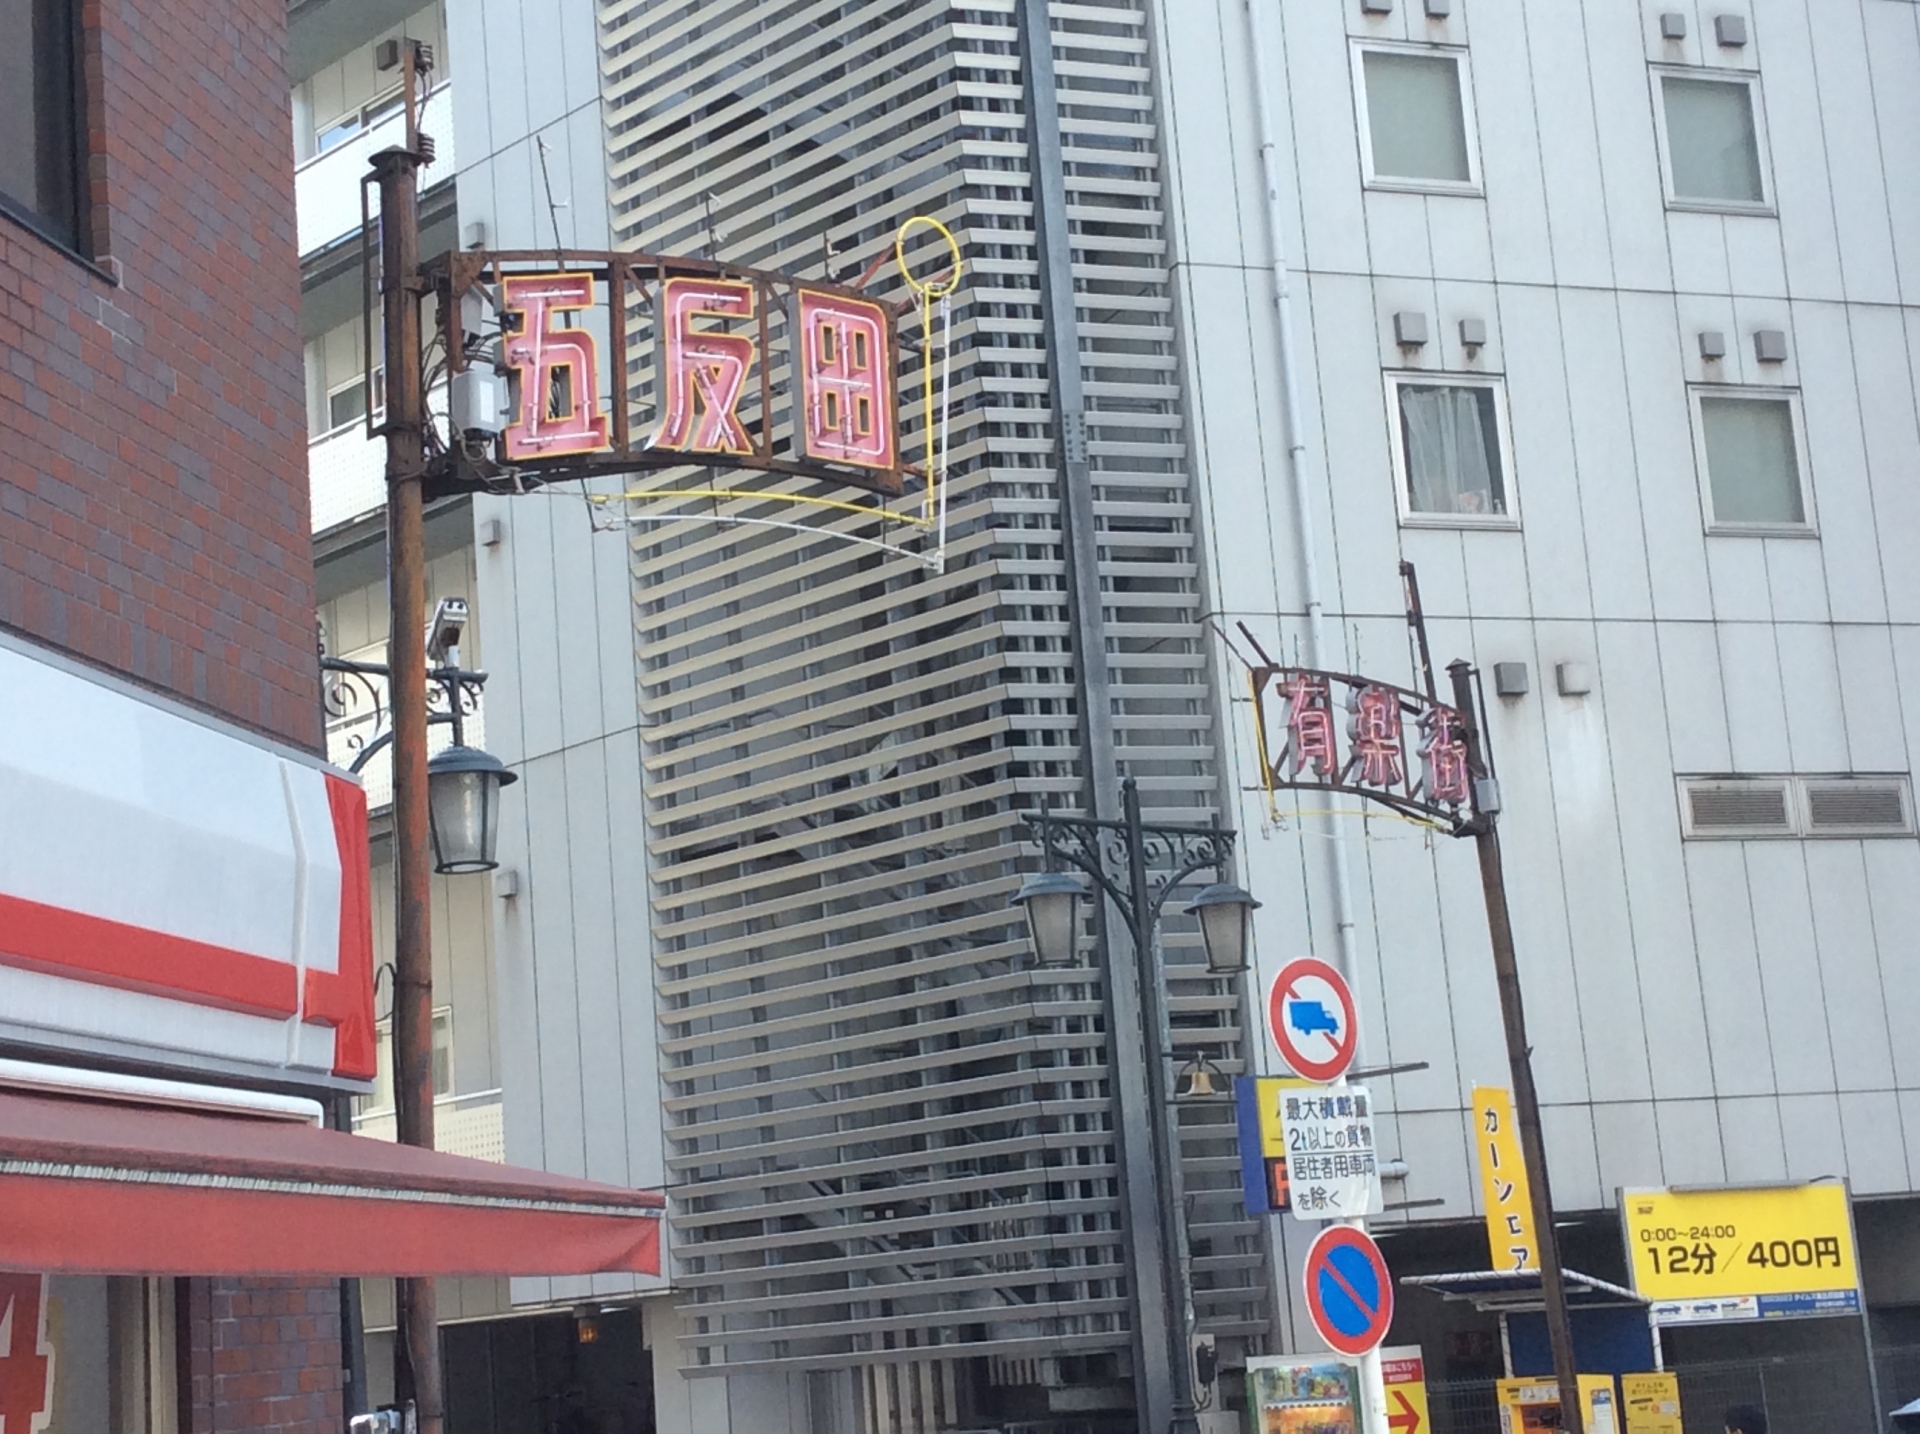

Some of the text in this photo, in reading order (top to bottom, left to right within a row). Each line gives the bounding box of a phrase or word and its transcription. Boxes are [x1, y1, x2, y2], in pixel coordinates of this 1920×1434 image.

[502, 272, 896, 471] 五反田
[1286, 1095, 1368, 1121] 最大積載量
[1289, 1125, 1372, 1151] 2t以上の貨物
[1293, 1153, 1376, 1180] 居住者用車両
[1297, 1186, 1341, 1210] を除く
